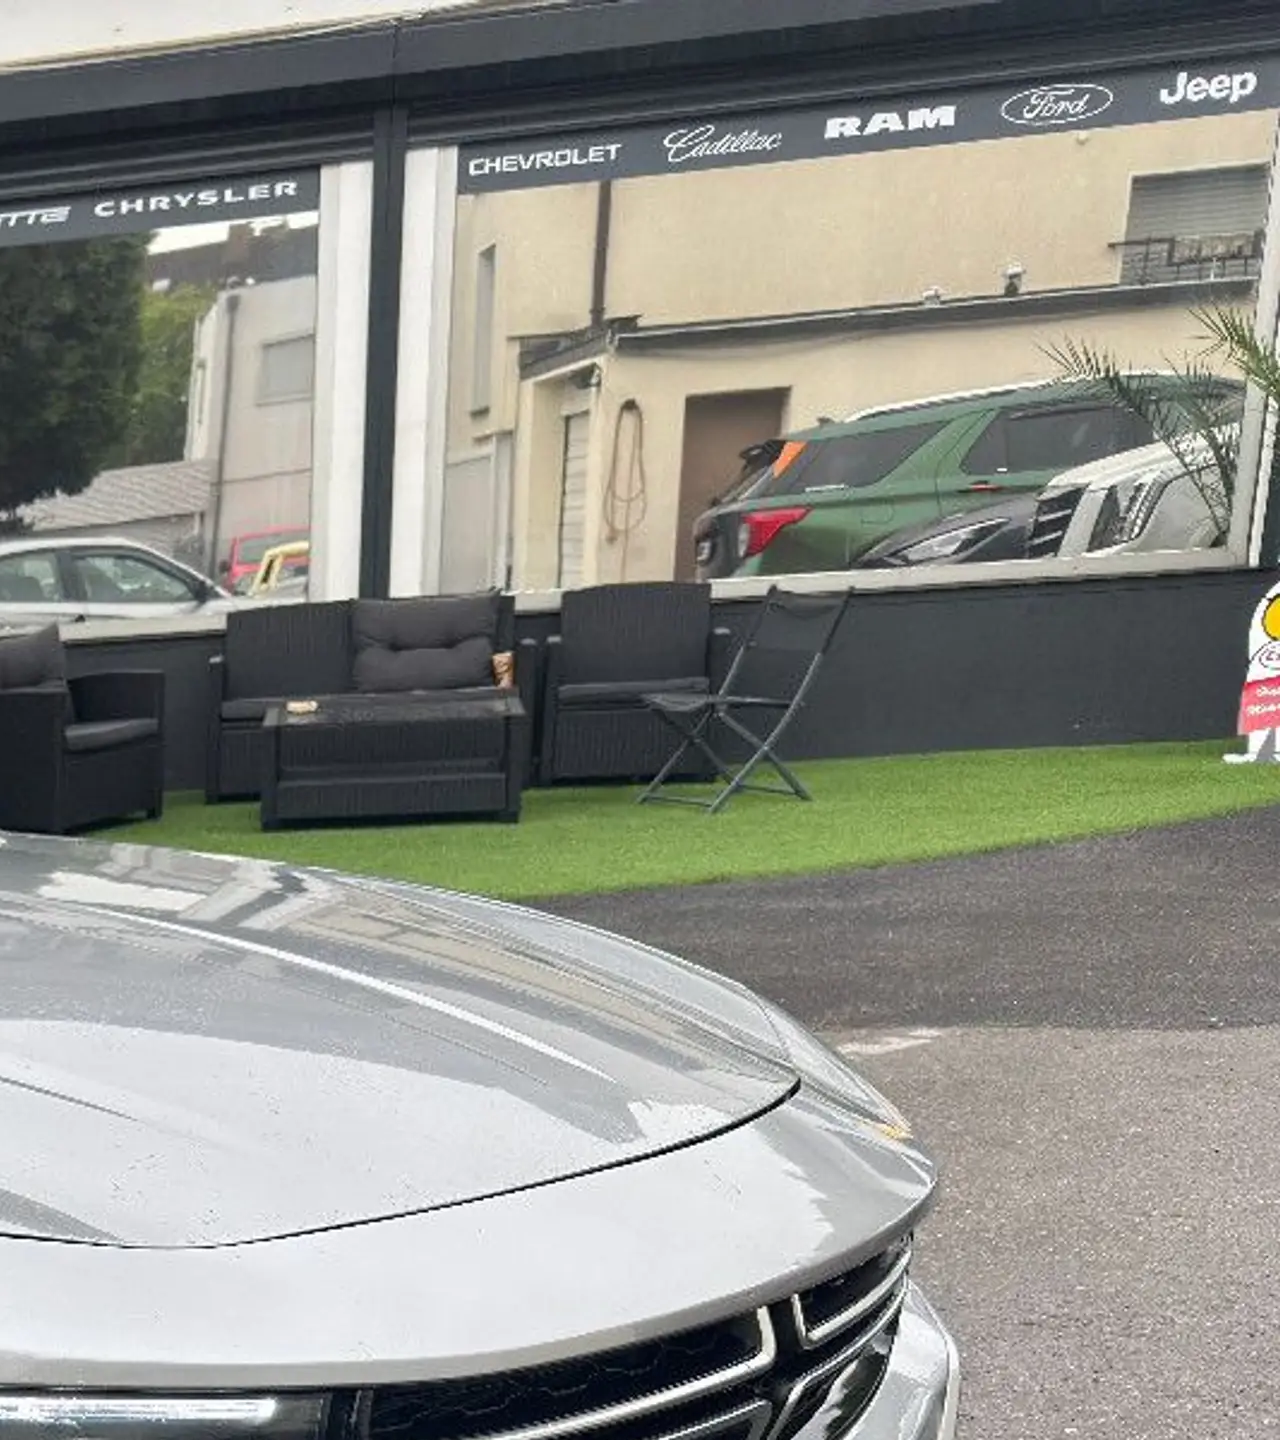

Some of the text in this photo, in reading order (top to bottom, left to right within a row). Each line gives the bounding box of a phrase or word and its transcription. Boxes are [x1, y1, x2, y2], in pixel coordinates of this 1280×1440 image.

[468, 143, 622, 176] CHEVROLET
[663, 124, 783, 163] Cadillac
[823, 105, 956, 139] RAM
[1159, 70, 1257, 104] Jeep
[94, 181, 298, 217] CHRYSLER
